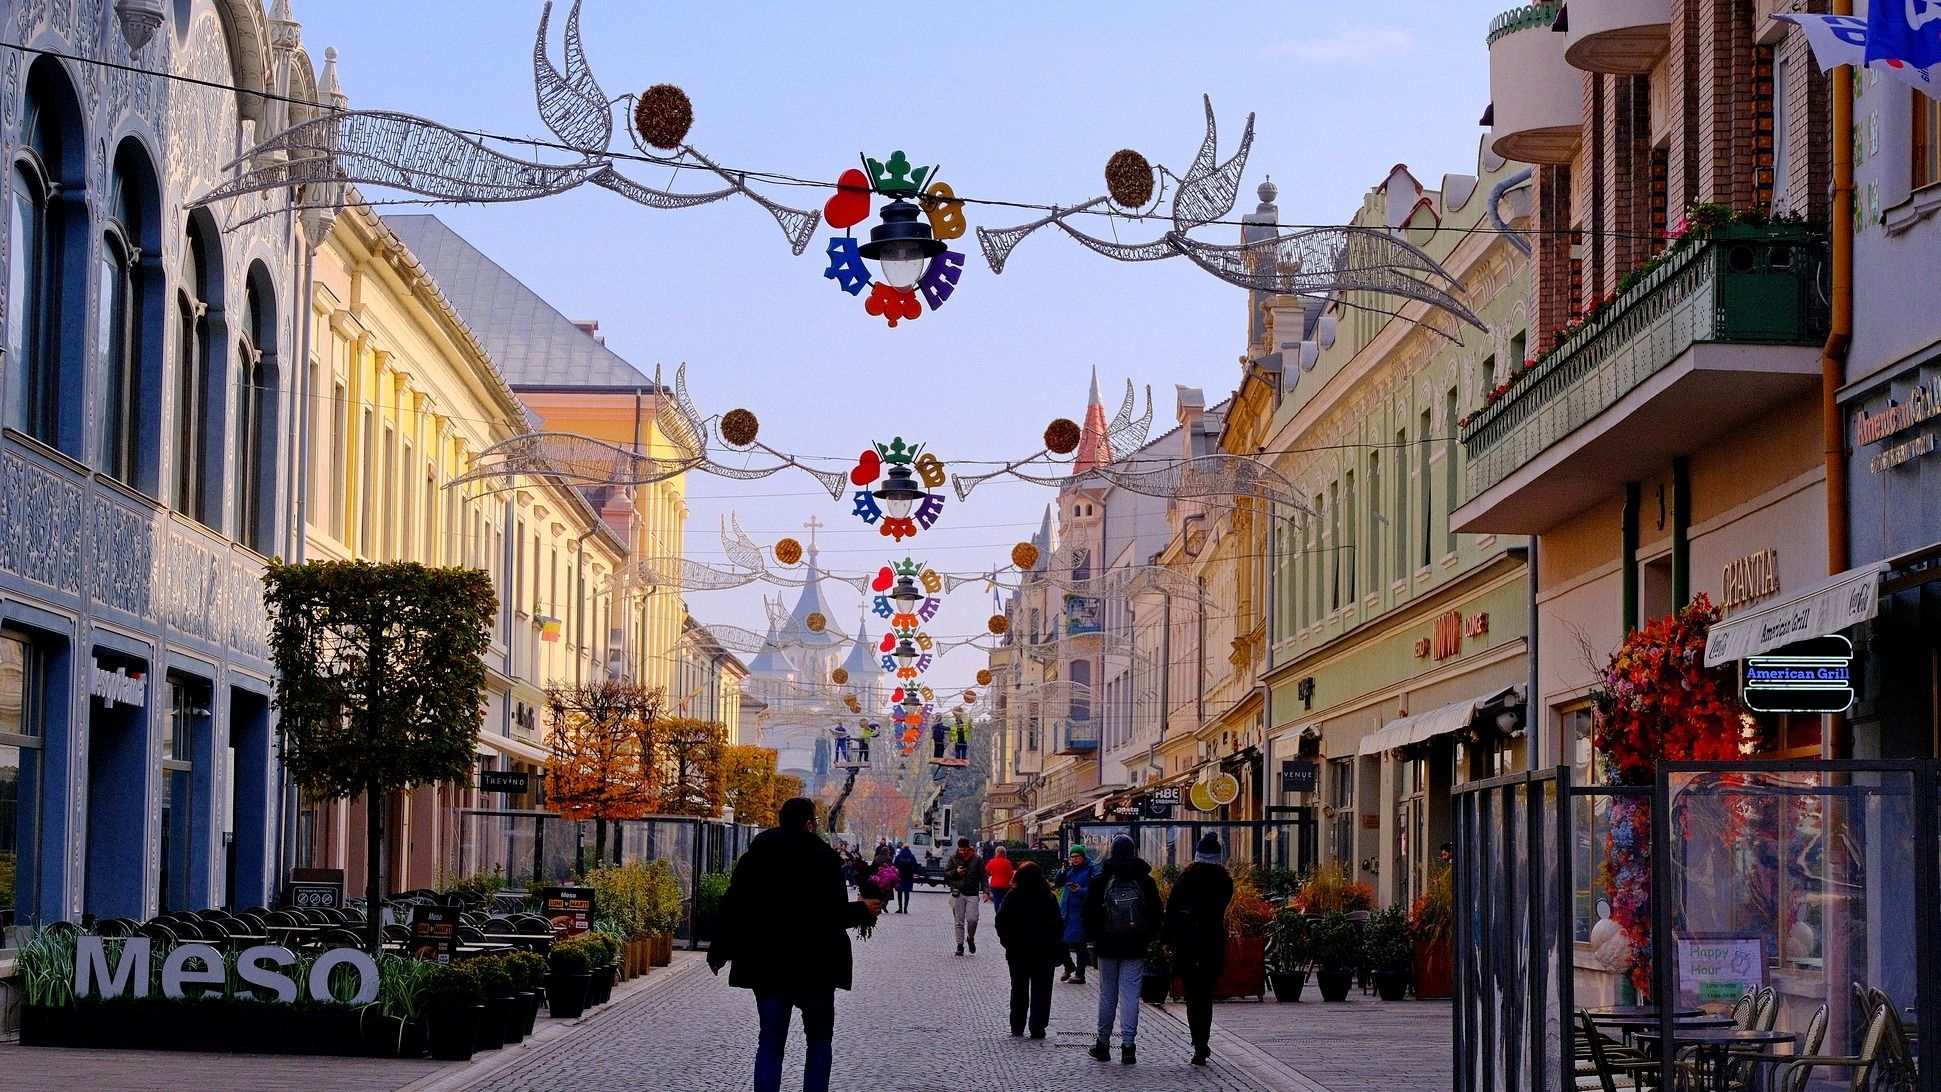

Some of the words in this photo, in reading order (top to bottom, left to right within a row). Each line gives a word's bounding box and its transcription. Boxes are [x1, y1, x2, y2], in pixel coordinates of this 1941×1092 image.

[1857, 399, 1914, 447] American
[1760, 616, 1791, 645] American
[1791, 607, 1811, 633] Grill
[1746, 667, 1815, 680] American
[1817, 667, 1850, 680] Grill
[484, 774, 525, 787] TREVINO
[1283, 771, 1313, 779] VENUE
[560, 891, 577, 899] Meso
[428, 912, 443, 921] Meso
[1690, 945, 1729, 960] Happy
[75, 936, 380, 1003] Meso
[1691, 964, 1721, 975] Hour
